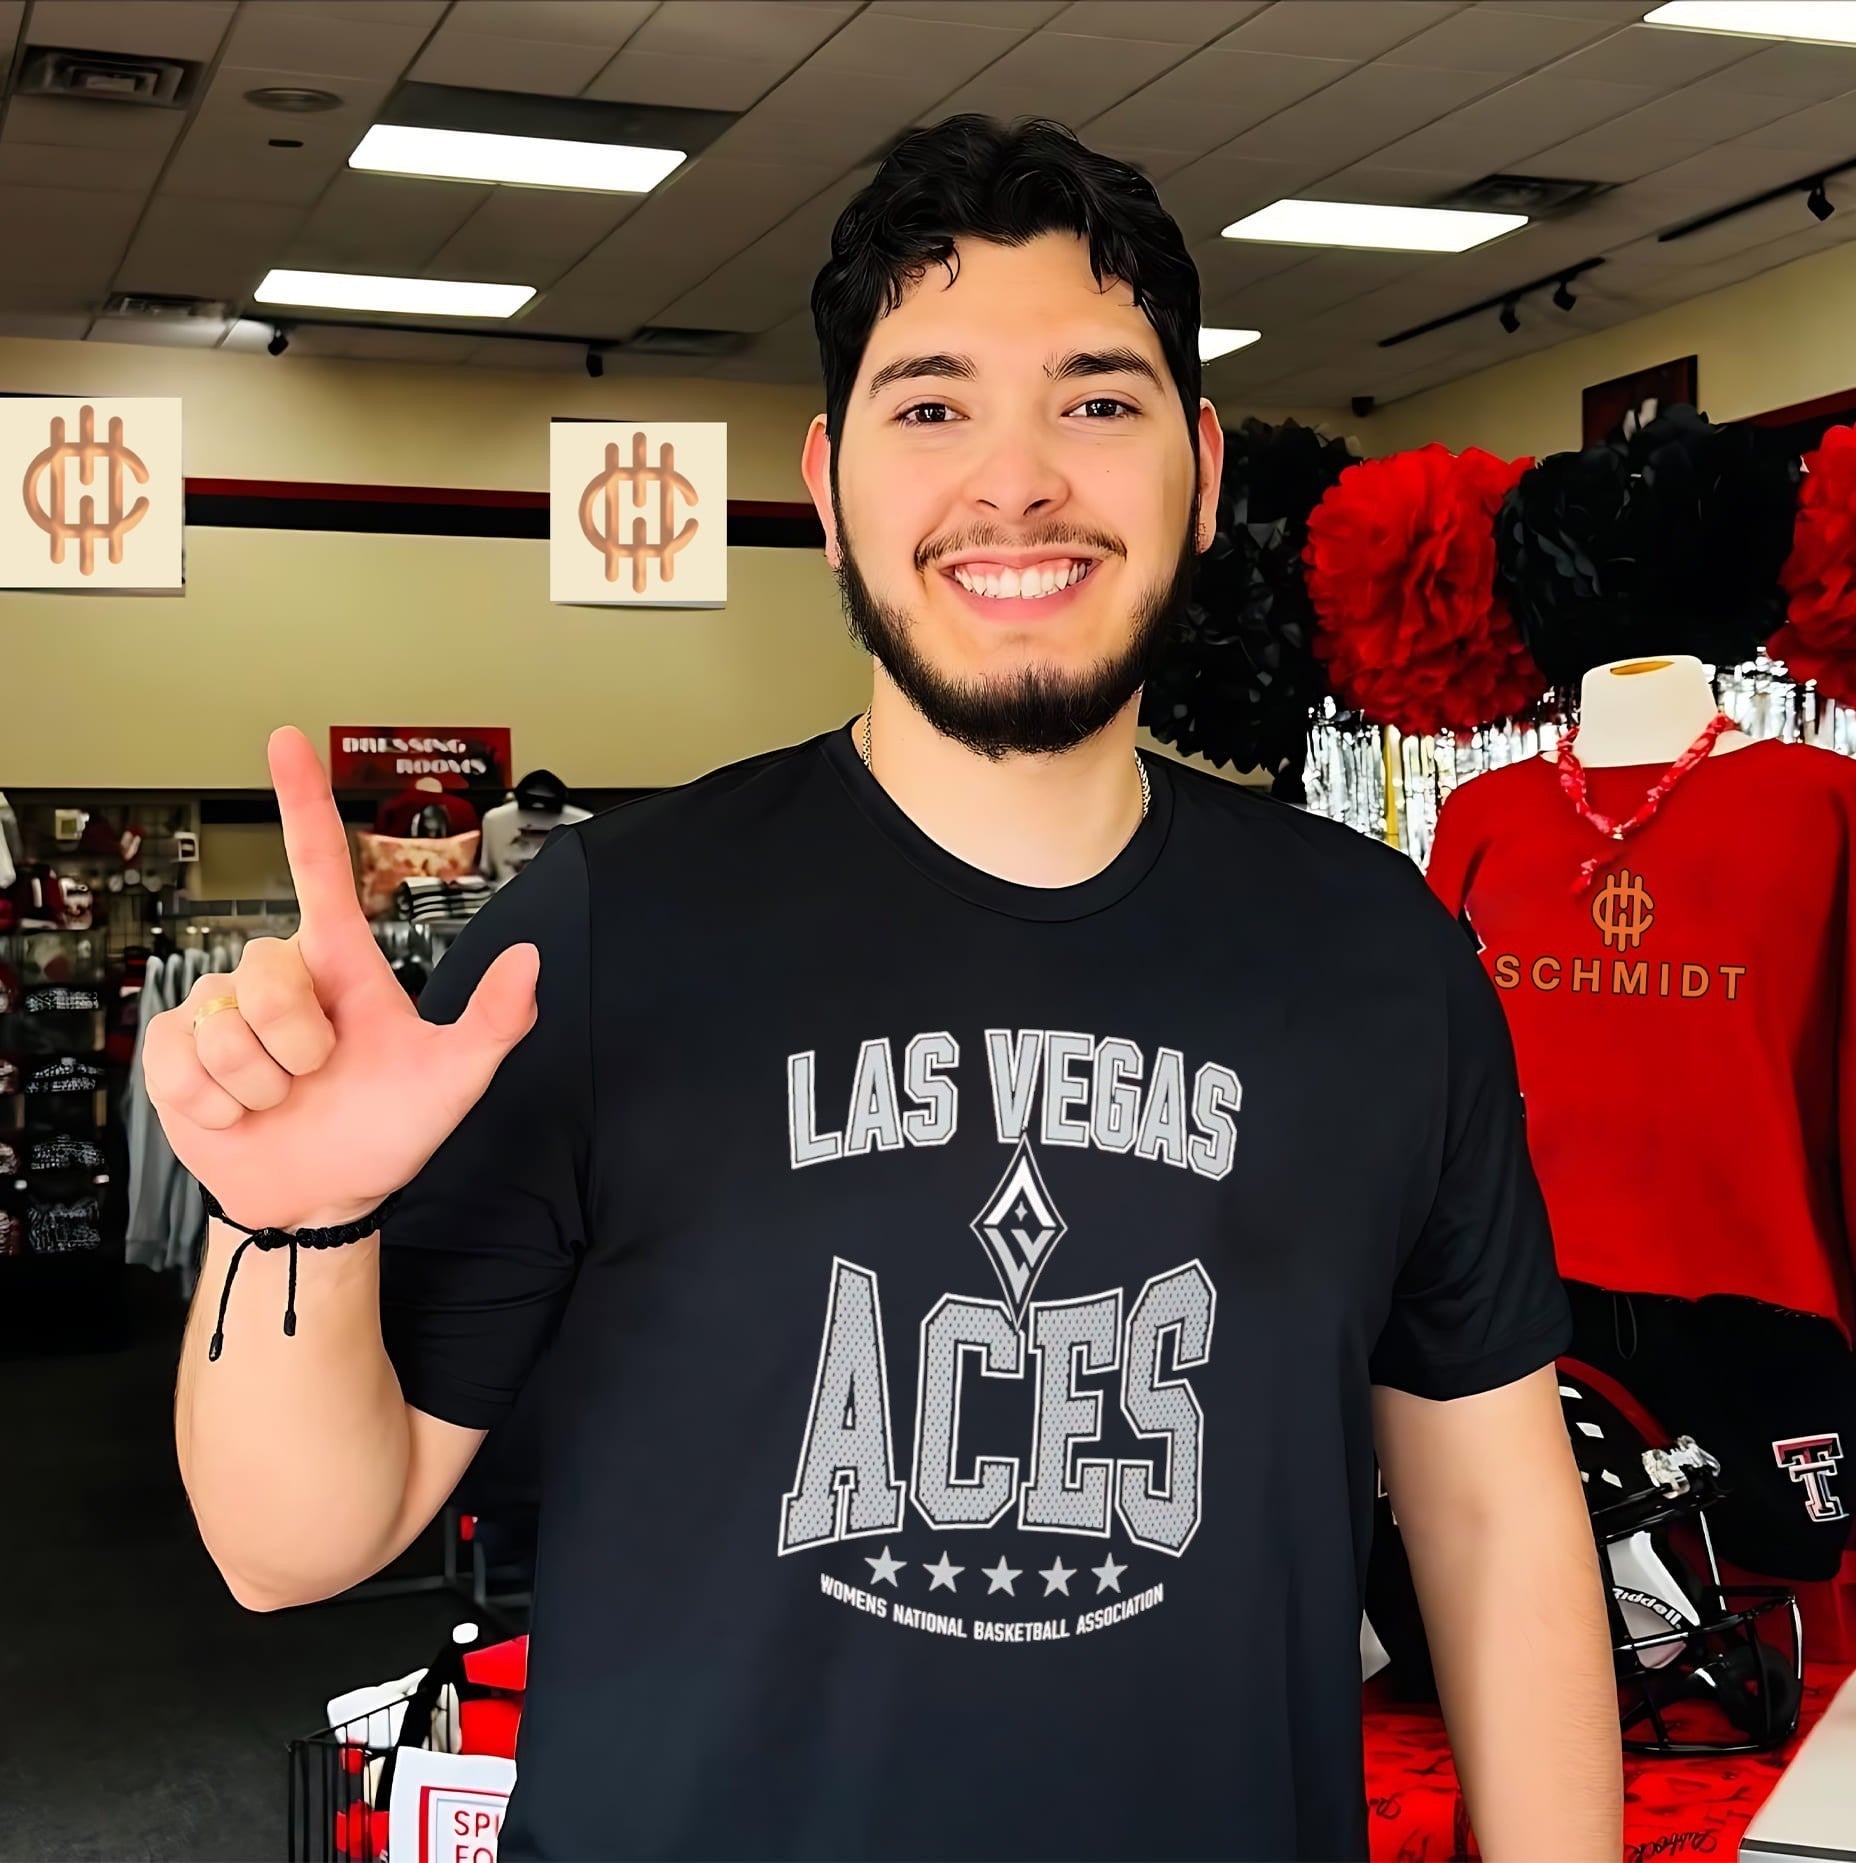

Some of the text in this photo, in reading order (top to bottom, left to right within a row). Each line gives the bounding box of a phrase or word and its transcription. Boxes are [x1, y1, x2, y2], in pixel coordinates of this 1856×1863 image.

[1494, 953, 1747, 1000] SCHMIDT
[787, 1029, 1242, 1181] LAS VEGAS
[778, 1256, 1217, 1557] ACES
[820, 1573, 1164, 1643] WOMENS NATIONAL BASKETBALL ASSOCIATION
[454, 1809, 500, 1838] SPI
